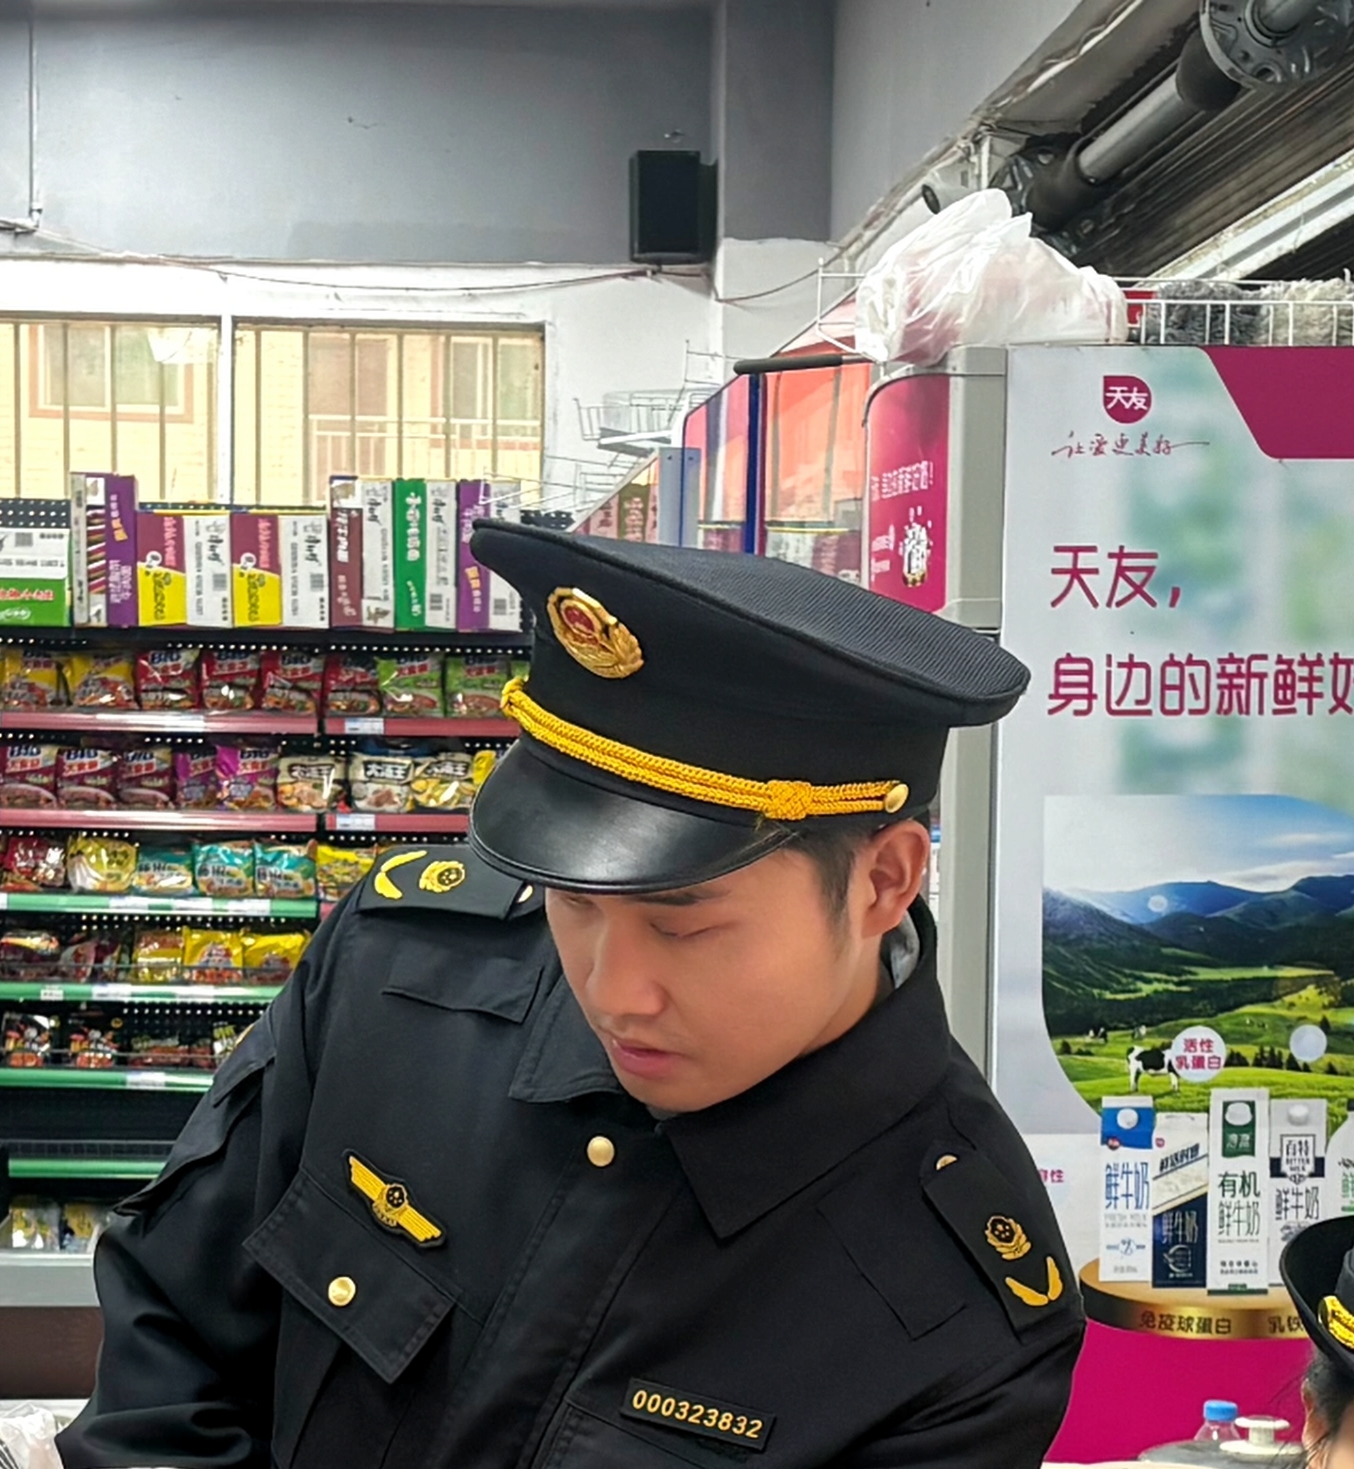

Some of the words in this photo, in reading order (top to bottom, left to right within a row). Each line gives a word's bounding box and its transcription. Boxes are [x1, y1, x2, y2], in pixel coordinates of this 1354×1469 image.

[1105, 386, 1148, 410] 天友
[1183, 1038, 1215, 1053] 活性
[1175, 1054, 1222, 1071] 乳蛋白
[1104, 1162, 1150, 1210] 鲜牛奶
[1218, 1170, 1261, 1198] 有机
[1275, 1186, 1319, 1220] 鲜牛奶
[1218, 1201, 1261, 1237] 鲜牛奶
[1138, 1311, 1231, 1335] 免疫球蛋白
[631, 1389, 764, 1439] 000323832
